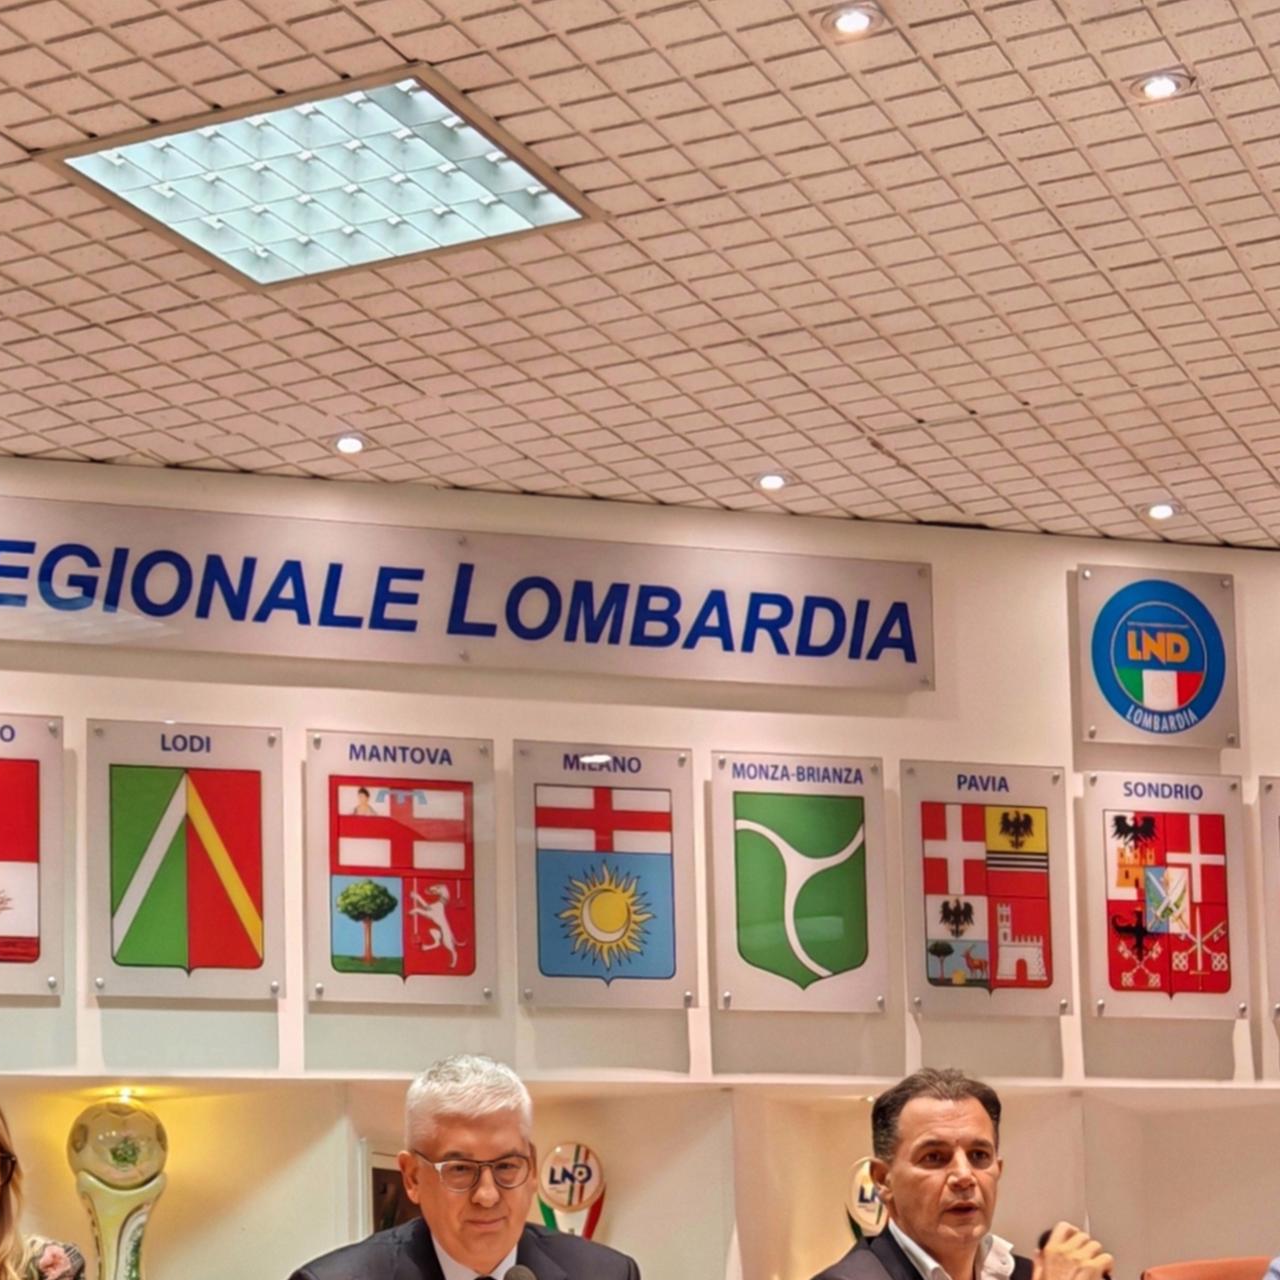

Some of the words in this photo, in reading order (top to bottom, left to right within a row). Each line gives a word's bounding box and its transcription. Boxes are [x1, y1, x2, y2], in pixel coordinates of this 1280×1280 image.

[446, 563, 917, 665] LOMBARDIA
[1127, 629, 1189, 665] LND
[1125, 704, 1198, 732] LOMBARDIA
[160, 733, 211, 753] LODI
[349, 743, 453, 767] MANTOVA
[732, 761, 864, 785] MONZA-BRIANZA
[957, 773, 1010, 793] PAVIA
[1123, 781, 1203, 801] SONDRIO
